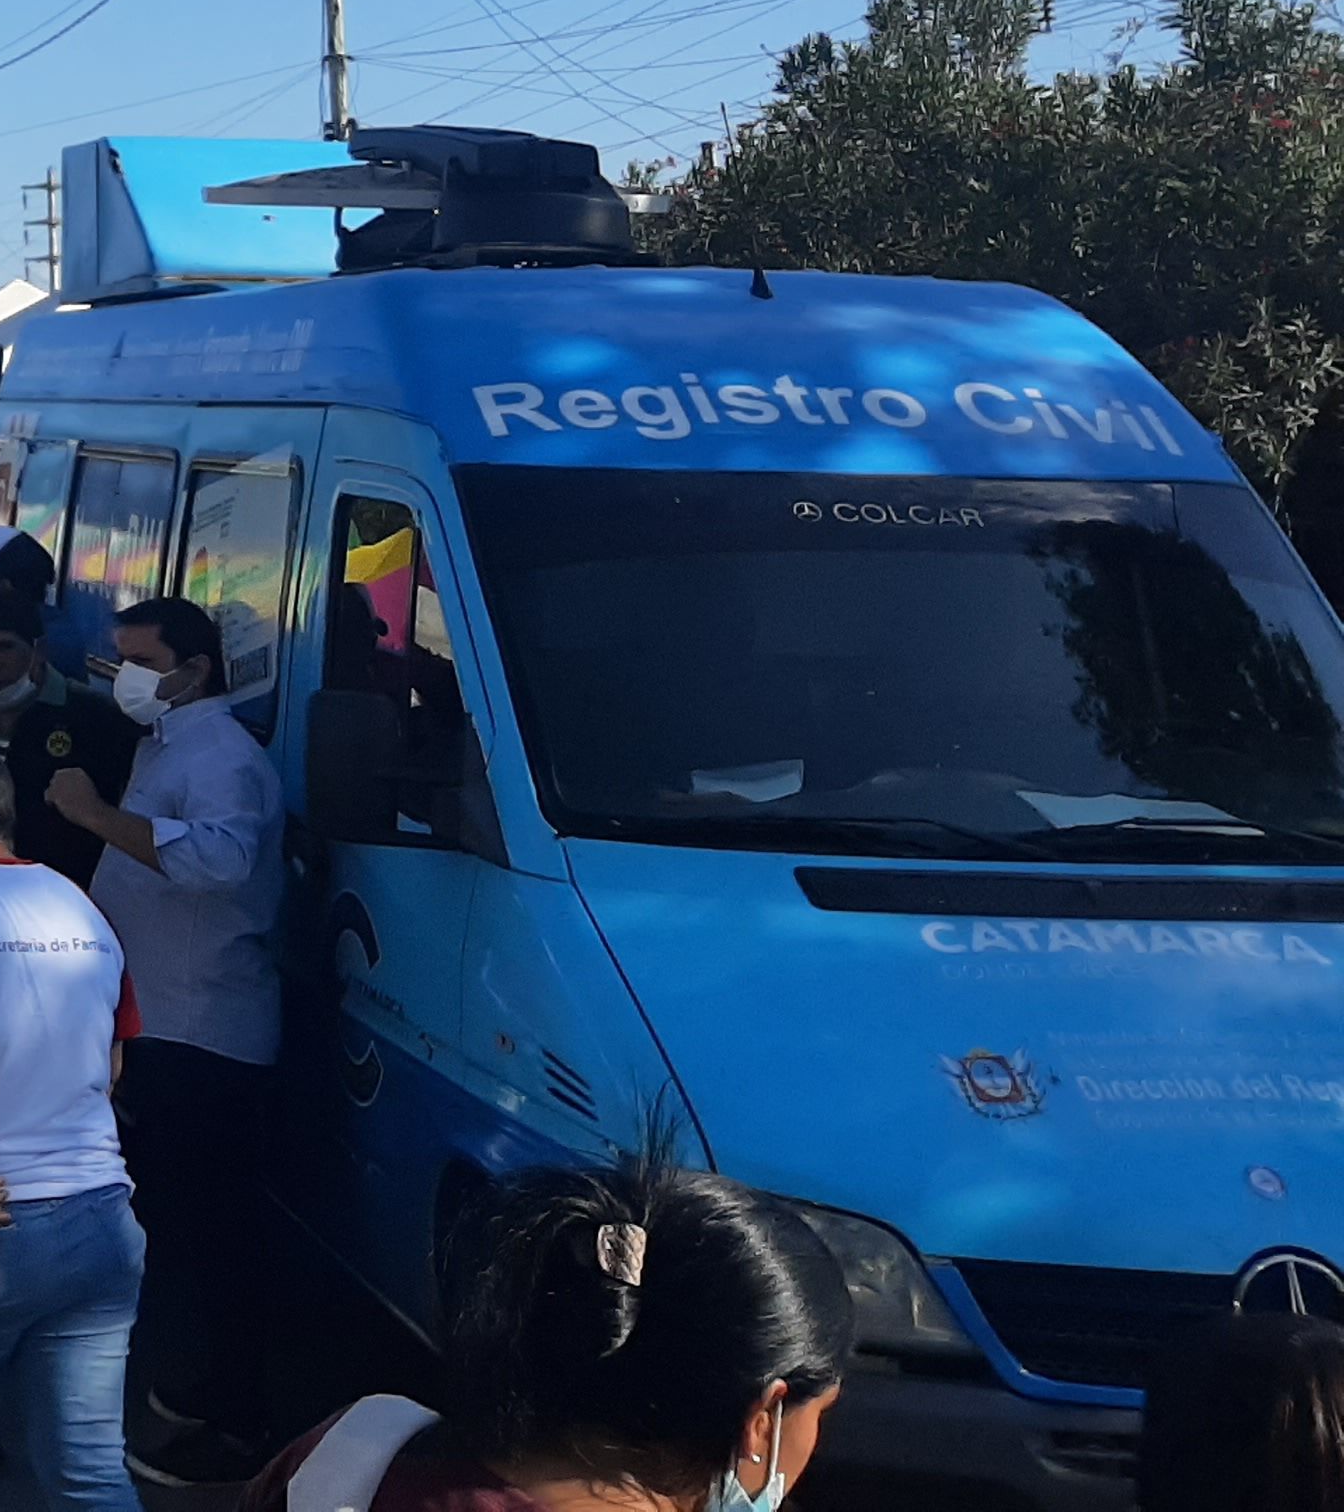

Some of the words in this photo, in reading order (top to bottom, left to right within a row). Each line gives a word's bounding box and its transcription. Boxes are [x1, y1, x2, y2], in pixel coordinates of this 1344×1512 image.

[472, 373, 926, 439] Registro
[953, 382, 1183, 456] Civil
[832, 502, 985, 529] COLCAR
[921, 921, 1334, 966] CATAMARCA
